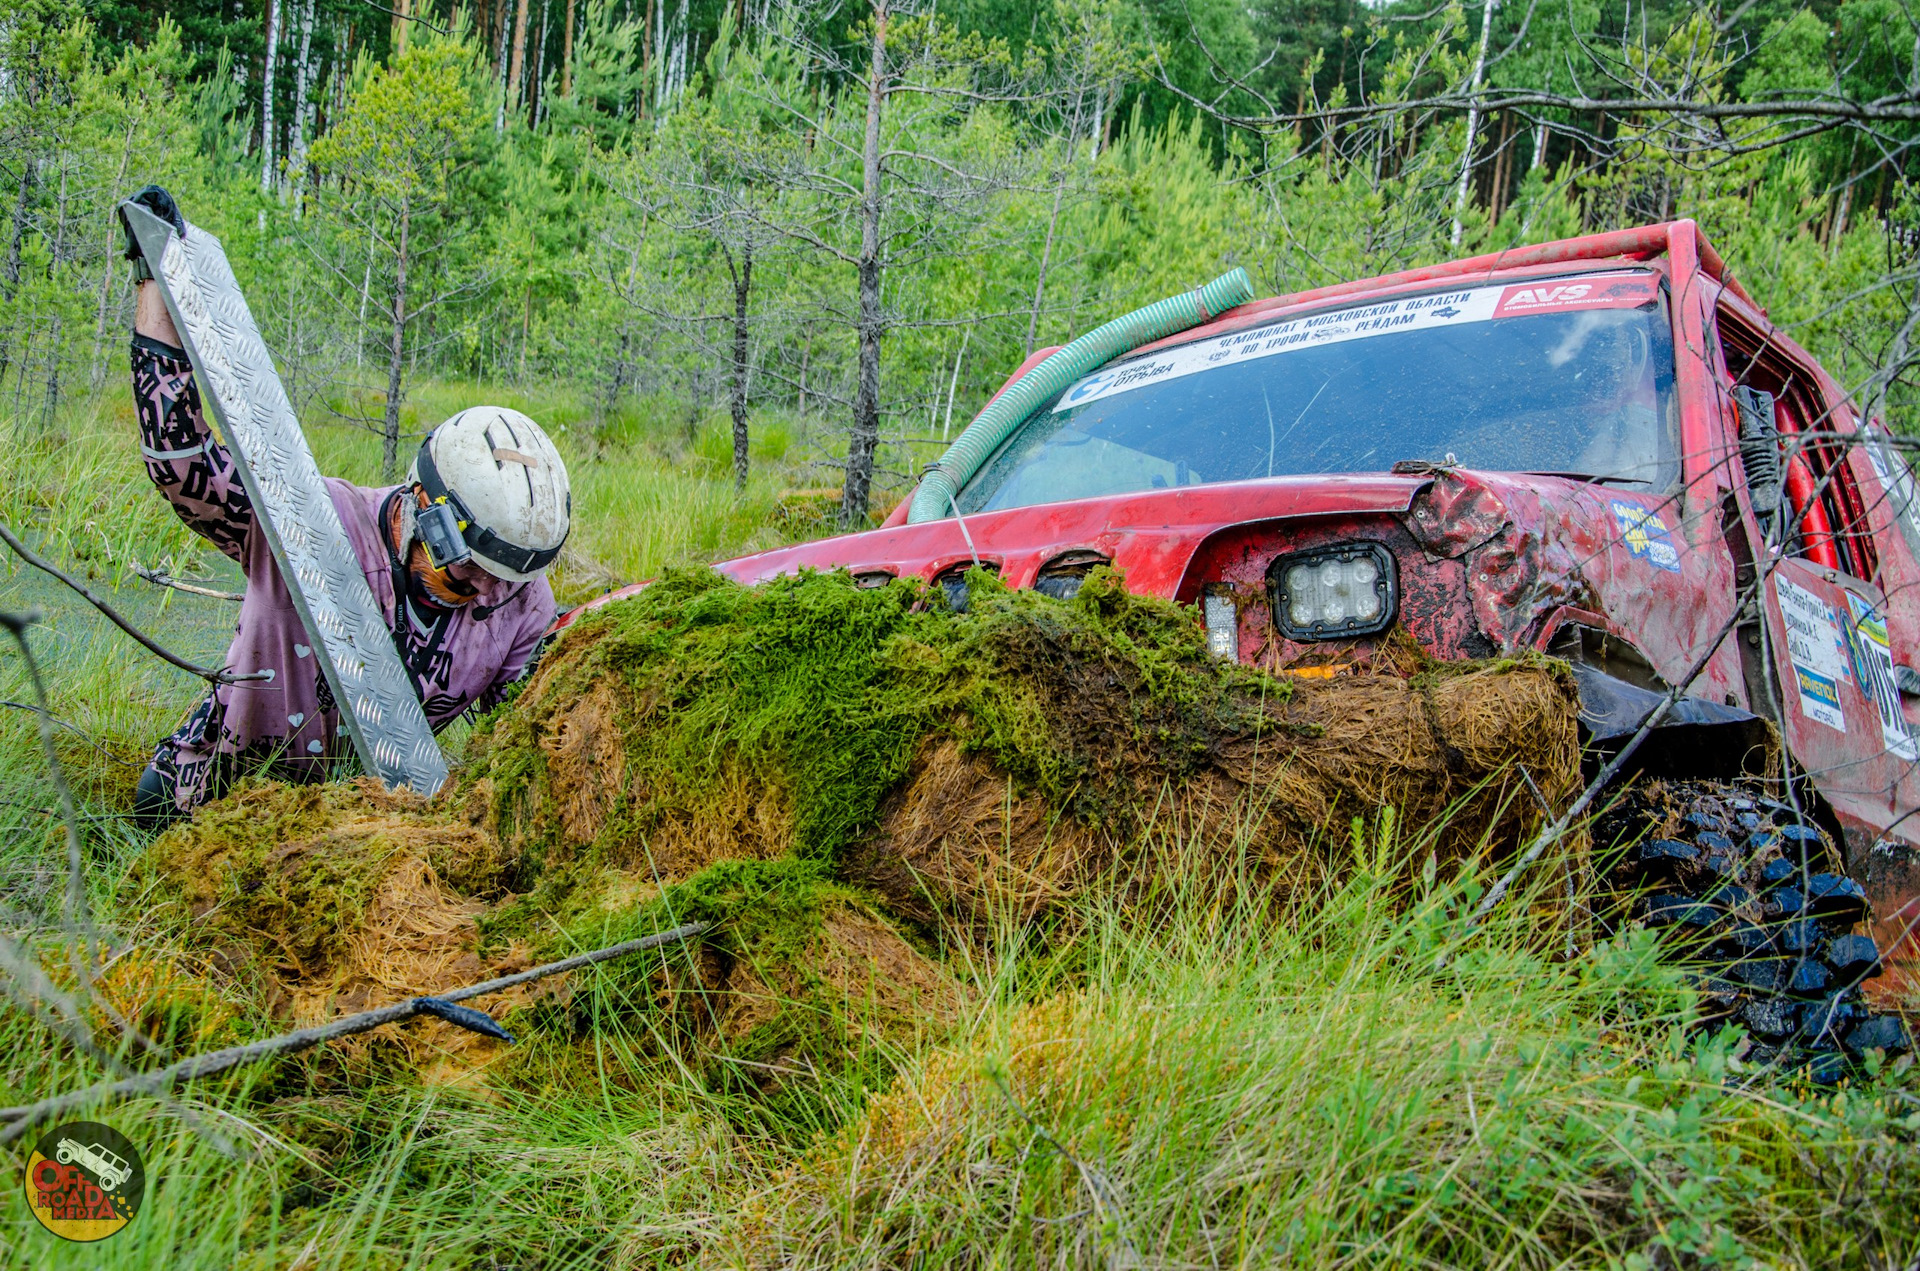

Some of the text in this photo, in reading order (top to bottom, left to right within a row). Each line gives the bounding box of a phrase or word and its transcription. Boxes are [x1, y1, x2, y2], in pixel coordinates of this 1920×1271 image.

[1503, 284, 1593, 307] AVS
[1219, 292, 1472, 348] ЧЕМПИОНАТ МОСКОВСКОЙ ОБЛАСТИ
[1240, 342, 1260, 356] ПО
[1265, 331, 1311, 350] ТРОФИ
[1354, 313, 1417, 332] РЕЙДАМ
[1112, 362, 1176, 388] ОТРЫВА
[1117, 361, 1156, 379] ТОЧКА
[1799, 672, 1837, 702] RAVENOL
